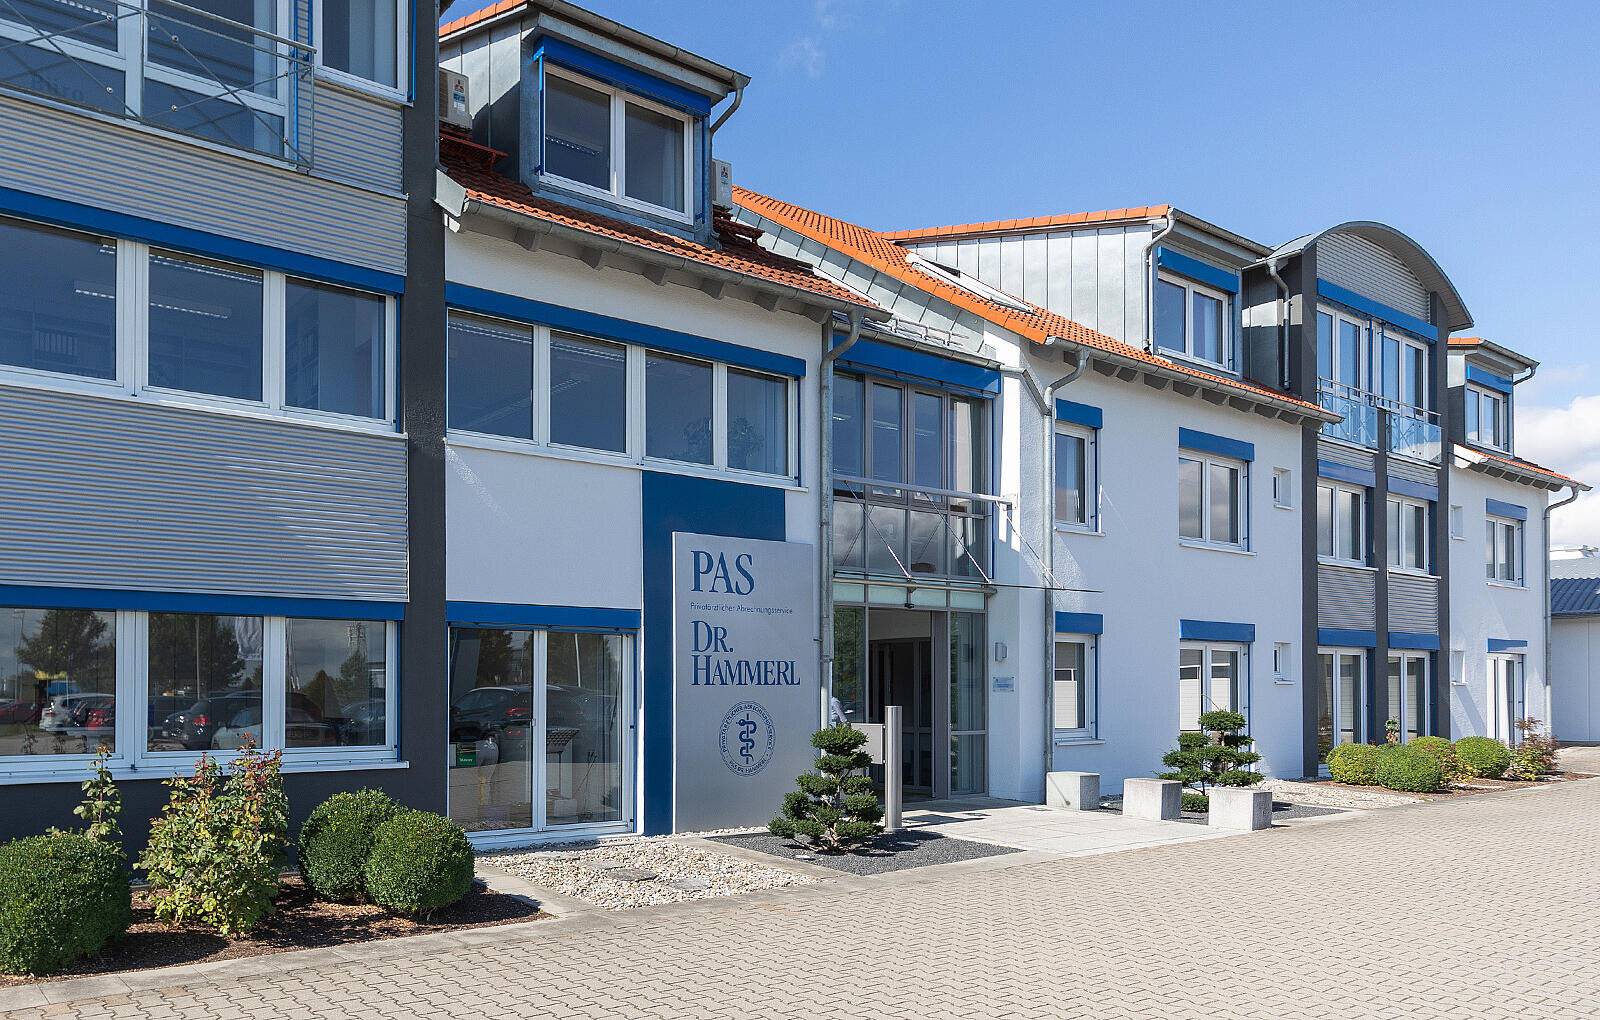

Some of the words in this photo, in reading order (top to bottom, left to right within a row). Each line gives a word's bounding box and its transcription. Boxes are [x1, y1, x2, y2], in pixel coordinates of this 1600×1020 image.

[690, 550, 755, 596] PAS
[690, 602, 735, 612] Privatärztlicher
[736, 603, 793, 615] Abrechnungsservice
[690, 620, 734, 652] DR.
[691, 654, 801, 686] HAMMERL
